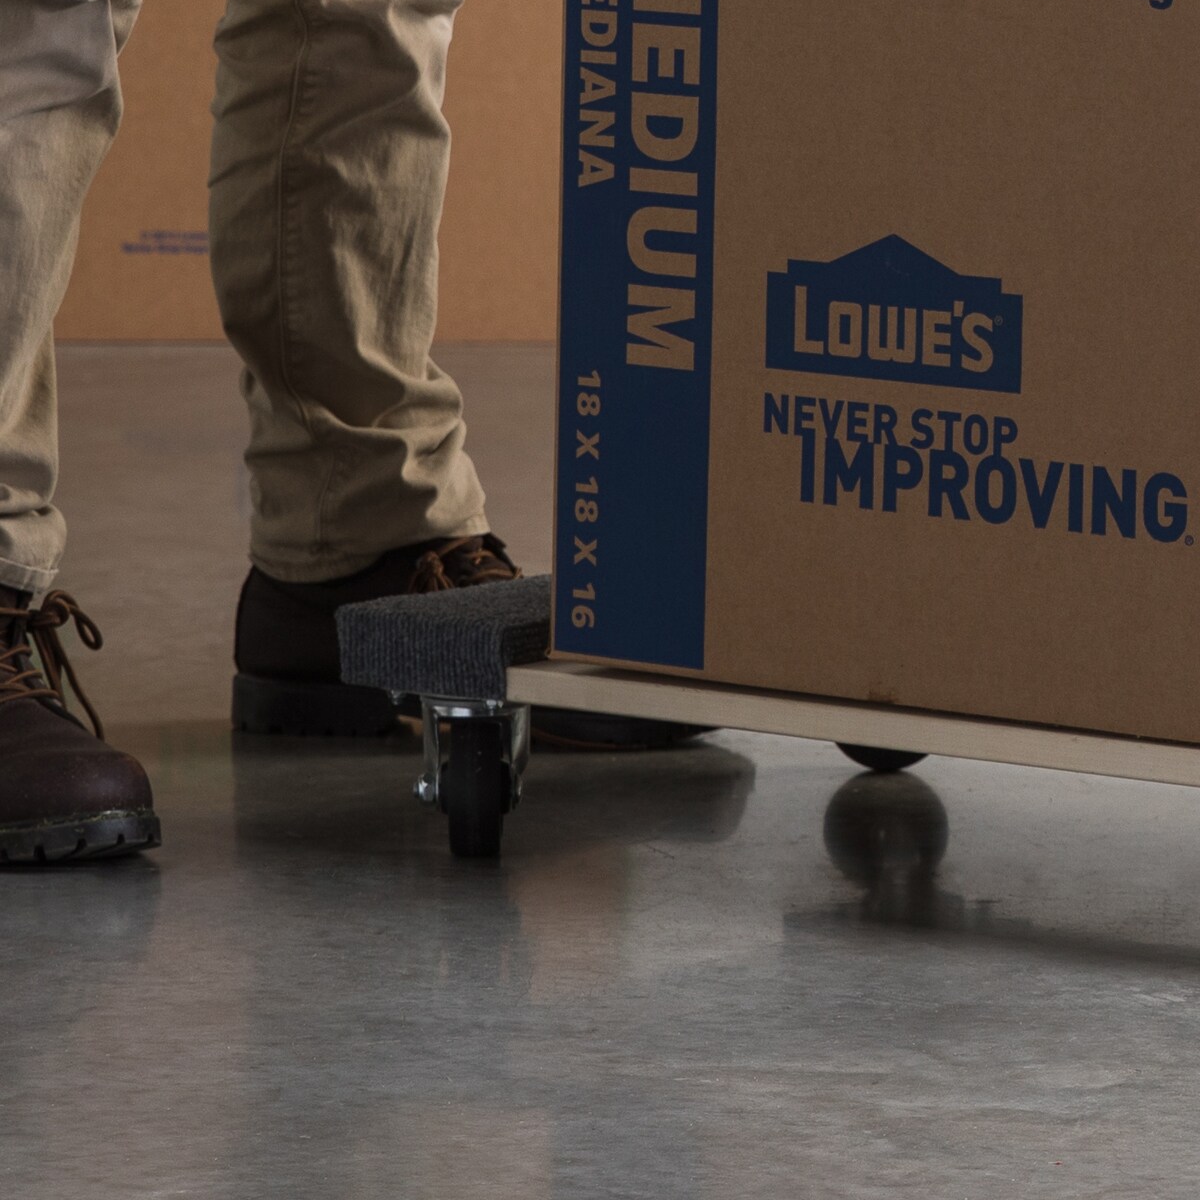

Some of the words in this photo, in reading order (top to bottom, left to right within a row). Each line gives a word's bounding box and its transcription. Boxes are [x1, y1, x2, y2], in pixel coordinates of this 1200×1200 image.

[794, 284, 994, 374] LOWE'S
[576, 369, 602, 417] 18
[575, 429, 600, 461] X
[763, 392, 898, 448] NEVER
[910, 408, 1018, 457] STOP
[574, 475, 600, 524] 18
[800, 427, 1188, 544] IMPROVING
[573, 535, 598, 566] X
[571, 581, 596, 630] 16
